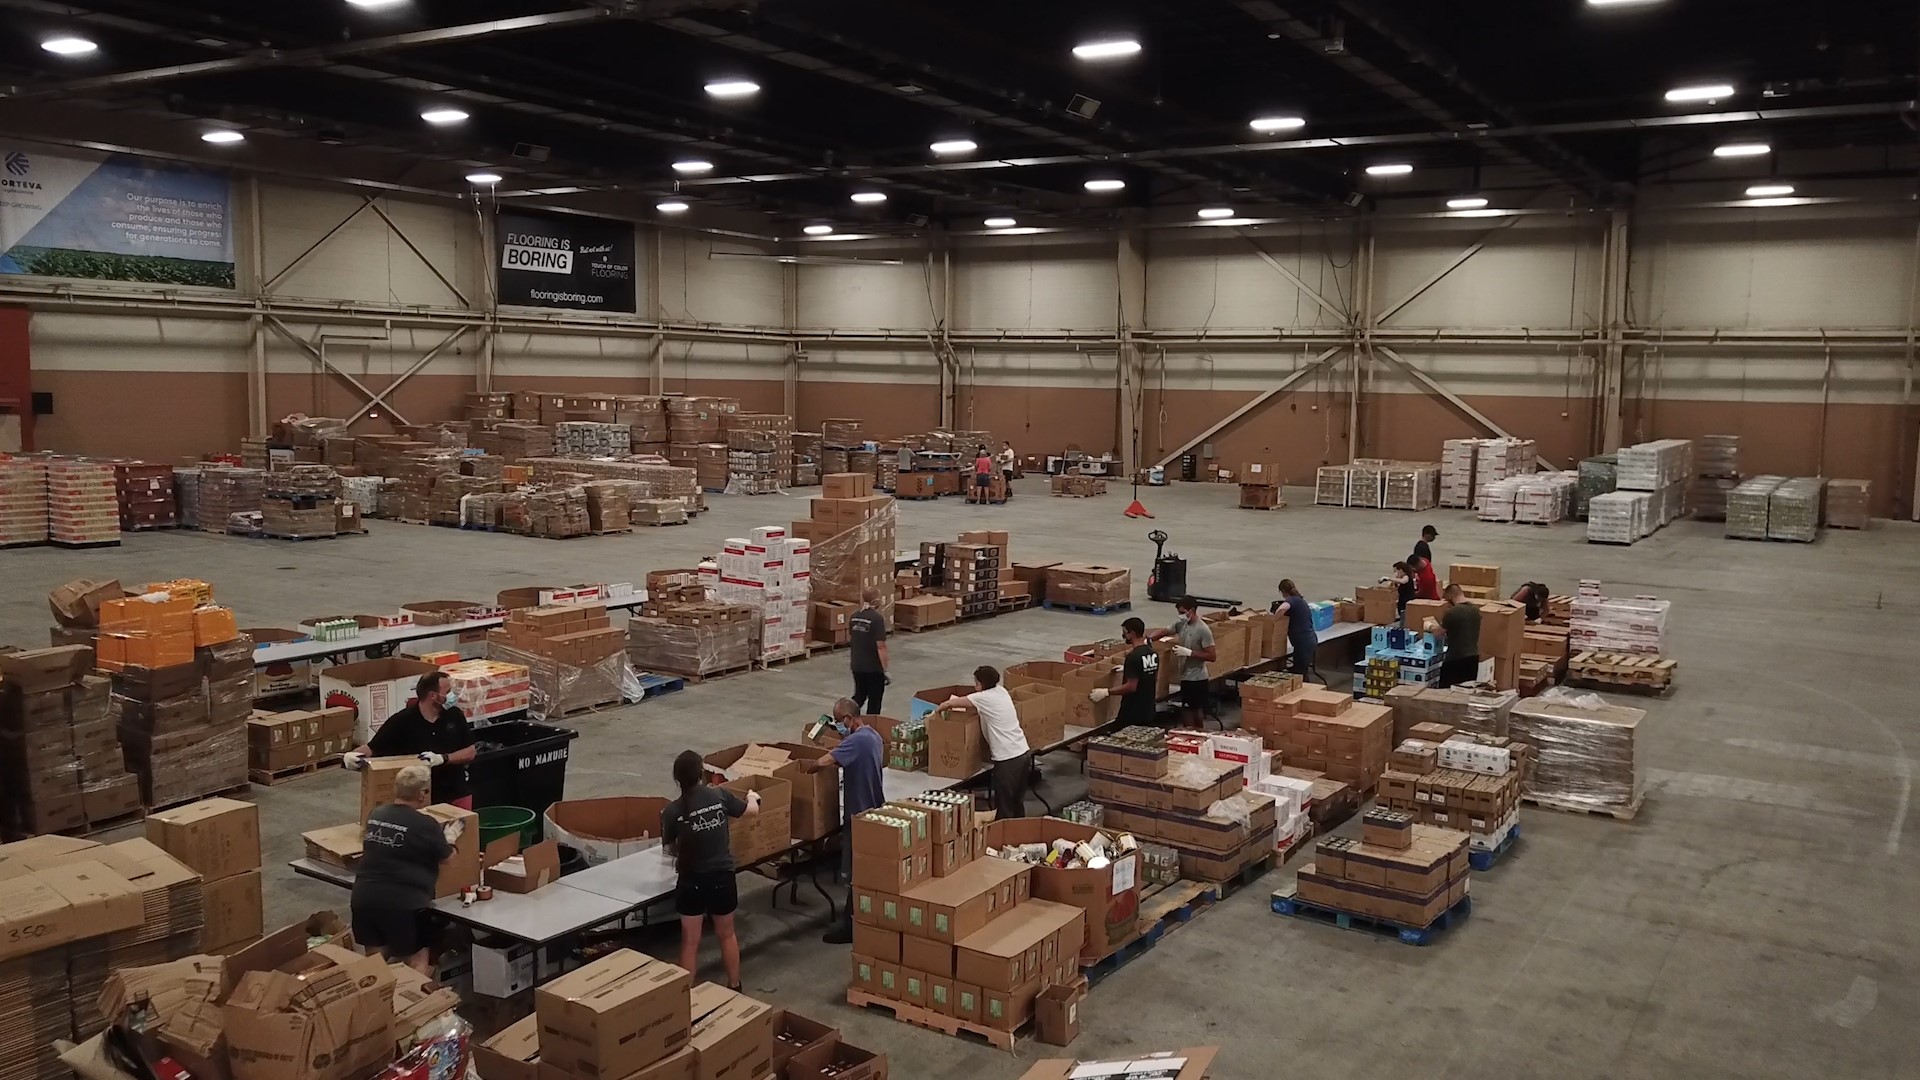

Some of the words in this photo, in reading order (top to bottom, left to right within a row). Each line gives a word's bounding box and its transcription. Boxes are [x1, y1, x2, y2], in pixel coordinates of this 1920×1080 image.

[1, 179, 42, 190] ORTEVA
[127, 193, 141, 201] Our
[144, 196, 178, 205] purpose
[179, 199, 186, 207] is
[188, 200, 196, 208] to
[198, 201, 222, 210] enrich
[137, 204, 150, 212] the
[152, 205, 170, 214] lives
[172, 207, 181, 215] of
[182, 209, 204, 218] those
[206, 211, 223, 220] who
[129, 213, 162, 222] produce
[165, 216, 181, 225] and
[182, 218, 204, 227] those
[206, 220, 223, 229] who
[111, 221, 151, 232] consume,
[152, 224, 187, 236] ensuring
[189, 229, 222, 239] progress
[125, 231, 138, 239] for
[140, 233, 188, 244] generations
[189, 237, 198, 245] to
[200, 239, 222, 247] come.
[507, 232, 559, 250] FLOORING
[560, 238, 571, 251] IS
[508, 248, 568, 269] BORING
[591, 268, 629, 280] FLOORING
[530, 288, 604, 305] flooringisboring.com
[340, 689, 360, 706] BRAND
[518, 757, 531, 770] NO
[535, 746, 568, 766] MANURE
